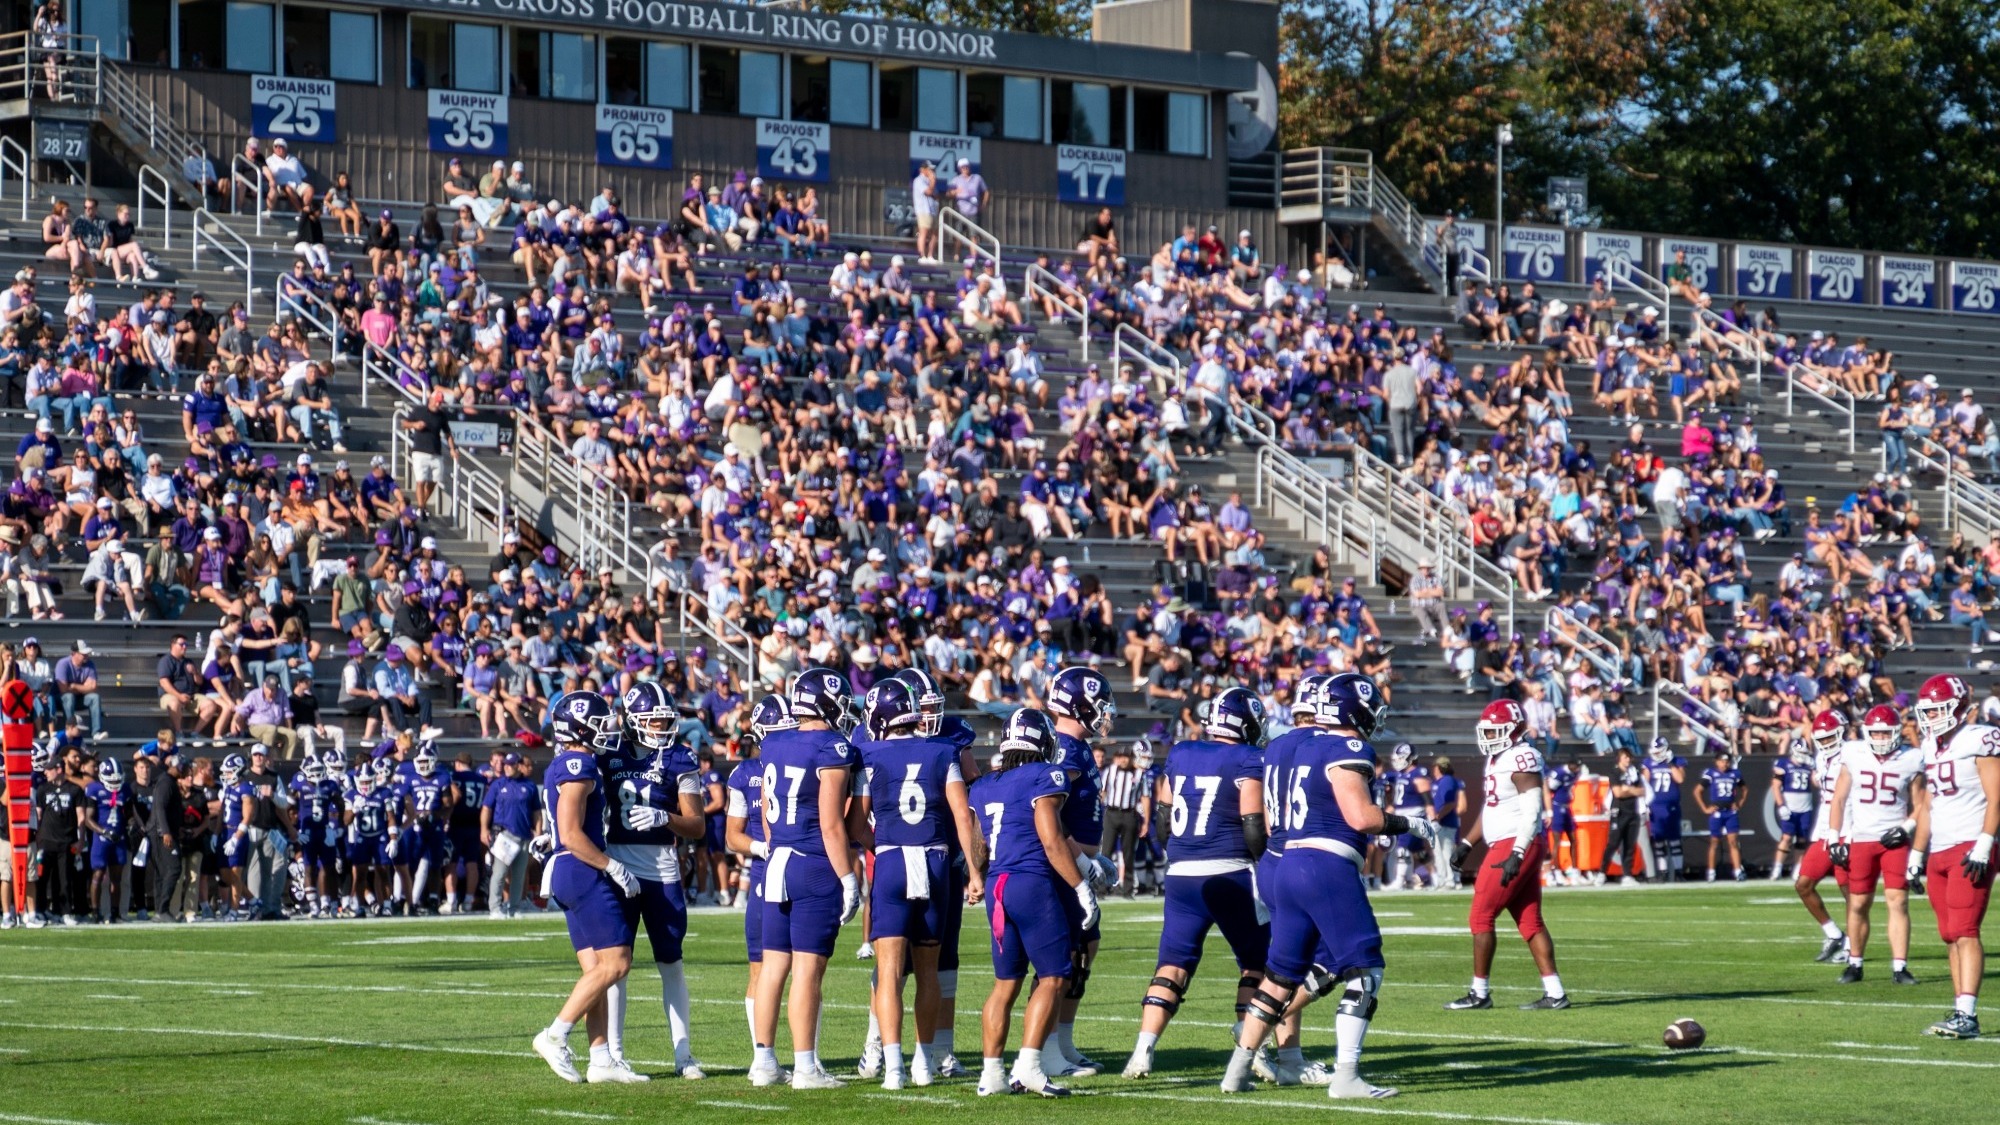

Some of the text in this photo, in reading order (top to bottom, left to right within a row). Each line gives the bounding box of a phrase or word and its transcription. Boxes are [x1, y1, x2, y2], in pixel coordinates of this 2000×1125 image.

[605, 0, 764, 35] FOOTBALL
[771, 14, 842, 43] RING
[850, 22, 888, 47] OF
[896, 27, 997, 58] HONOR
[256, 78, 331, 96] OSMANSKI
[439, 93, 497, 109] MURPHY
[267, 94, 322, 137] 25
[602, 108, 666, 124] PROMUTO
[443, 108, 495, 149] 35
[764, 121, 822, 138] PROVOST
[43, 137, 82, 157] 28 27
[611, 121, 660, 162] 65
[919, 135, 973, 150] FENERTY
[770, 136, 818, 176] 43
[1060, 147, 1123, 163] LOCKBAUM
[1071, 161, 1114, 199] 17
[888, 203, 904, 220] 26
[1509, 229, 1561, 243] KOZERSKI
[1597, 236, 1630, 250] TURCO
[1516, 242, 1555, 278] 76
[1749, 249, 1781, 261] QUEHL
[1818, 254, 1856, 268] CIACCIO
[1884, 260, 1932, 273] HENNESSEY
[1748, 260, 1784, 294] 37
[1820, 265, 1854, 300] 20
[1958, 265, 1999, 278] VERRETTE
[1892, 271, 1926, 305] 34
[1962, 276, 1996, 310] 26
[464, 429, 484, 442] Fox
[1515, 751, 1537, 772] 83
[465, 781, 484, 809] 57
[763, 763, 806, 825] 87
[898, 763, 926, 825] 6
[1859, 770, 1900, 806] 35
[312, 799, 322, 822] 5
[416, 790, 436, 811] 27
[1170, 775, 1223, 837] 67
[984, 802, 1005, 861] 7
